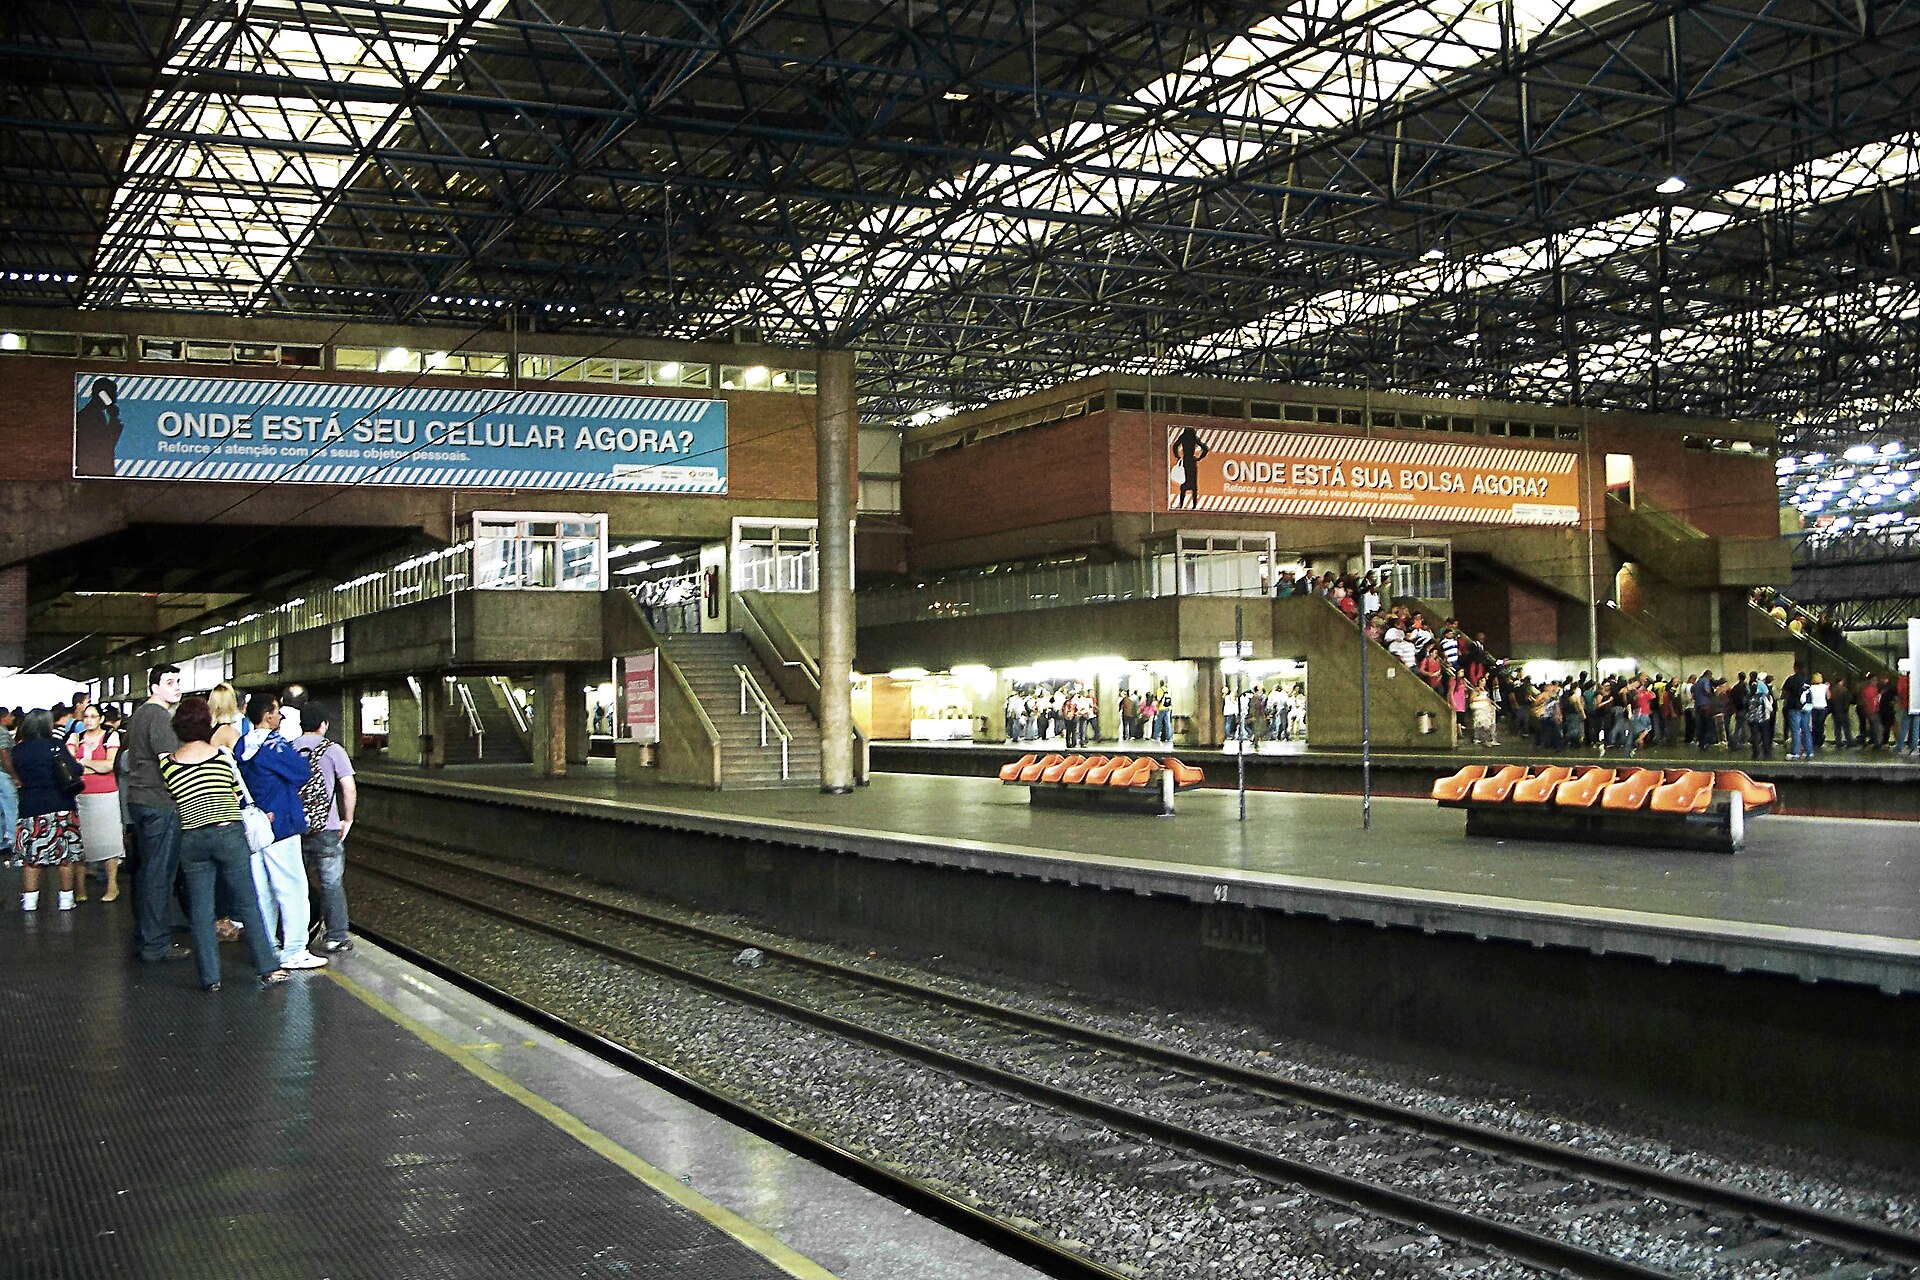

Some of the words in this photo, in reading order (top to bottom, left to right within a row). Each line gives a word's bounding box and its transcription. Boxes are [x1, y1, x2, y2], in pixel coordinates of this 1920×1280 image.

[157, 411, 253, 439] ONDE
[262, 411, 345, 441] ESTÁ
[352, 417, 417, 445] SEU
[424, 419, 565, 449] CELULAR
[574, 426, 695, 454] AGORA?
[157, 440, 211, 454] Reforce
[225, 442, 277, 458] atenção
[280, 447, 309, 457] com
[330, 449, 360, 458] seus
[412, 450, 470, 462] pessoais.
[1222, 459, 1287, 484] ONDE
[1292, 461, 1347, 487] ESTÁ
[1350, 466, 1394, 489] SUA
[1400, 469, 1466, 494] BOLSA
[1471, 473, 1550, 499] AGORA?
[1223, 483, 1257, 494] Reforce
[1299, 488, 1317, 497] com
